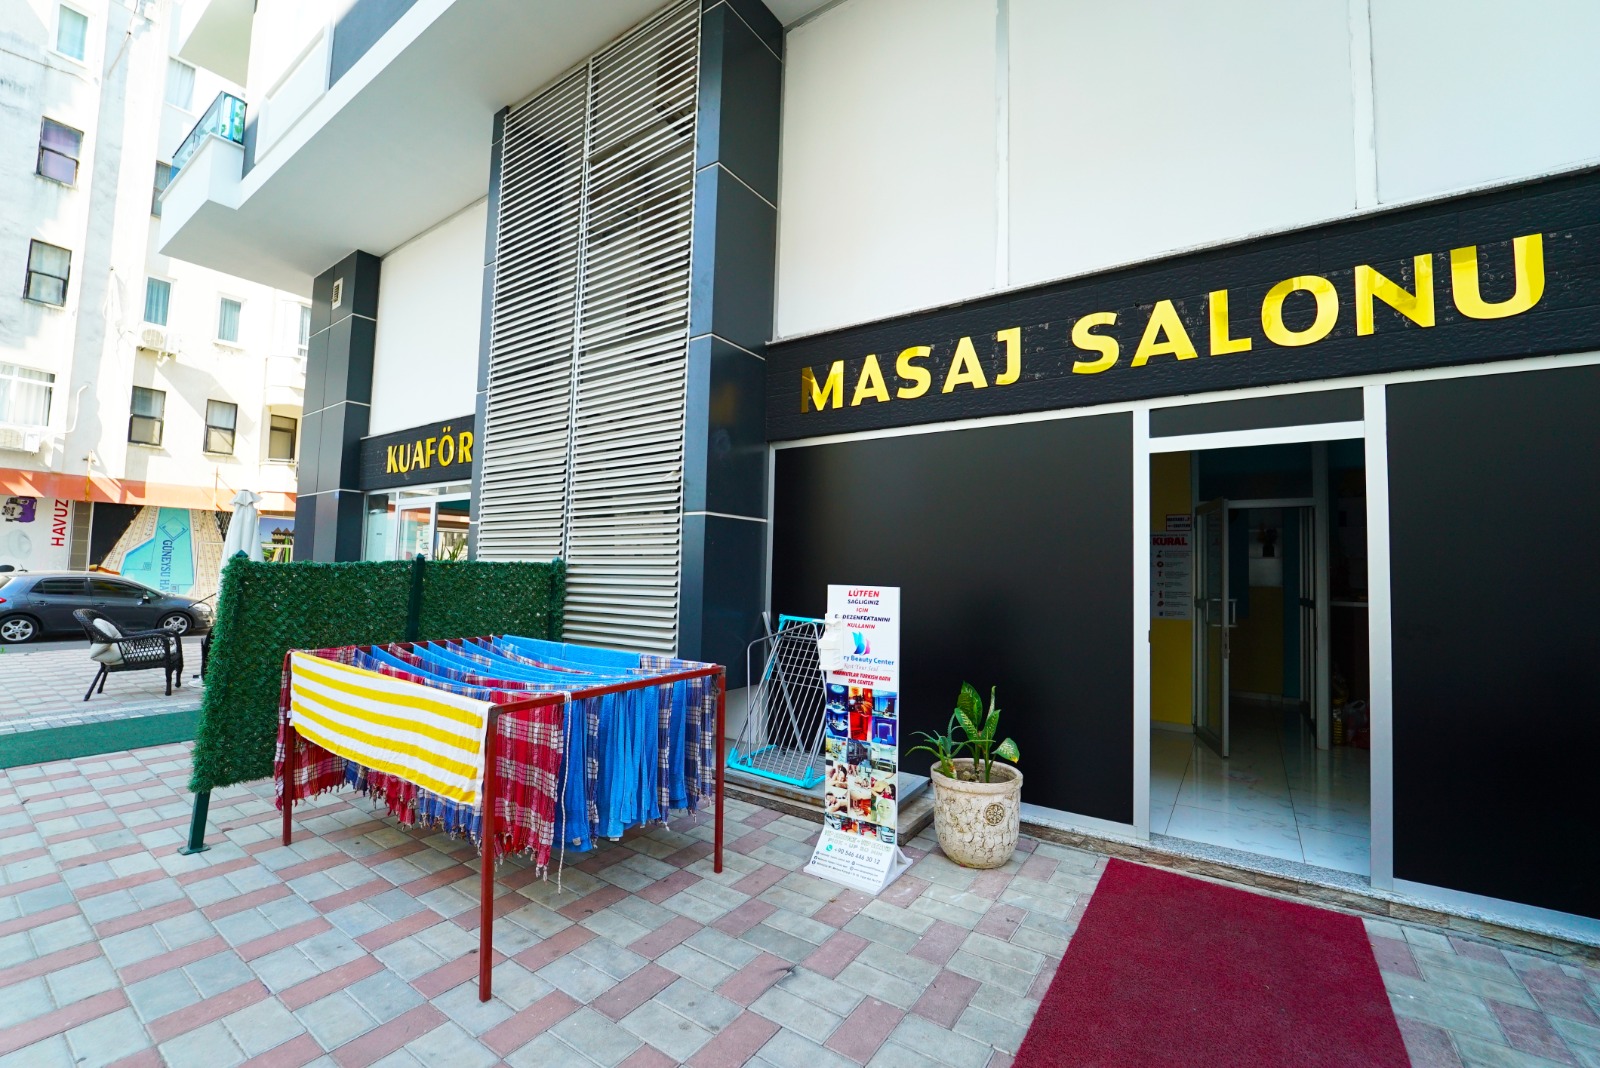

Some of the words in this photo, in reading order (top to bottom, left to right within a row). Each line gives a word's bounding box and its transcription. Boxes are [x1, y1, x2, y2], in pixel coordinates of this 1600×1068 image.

[801, 327, 1021, 413] MASAJ
[1071, 233, 1545, 374] SALONU
[386, 426, 474, 474] KUAFÖR
[51, 499, 69, 546] HAVUZ
[1152, 537, 1188, 545] KURAL
[161, 540, 174, 577] GÜNEYSU
[848, 588, 880, 598] LÜTFEN
[850, 654, 873, 664] Beauty
[873, 657, 895, 666] Center
